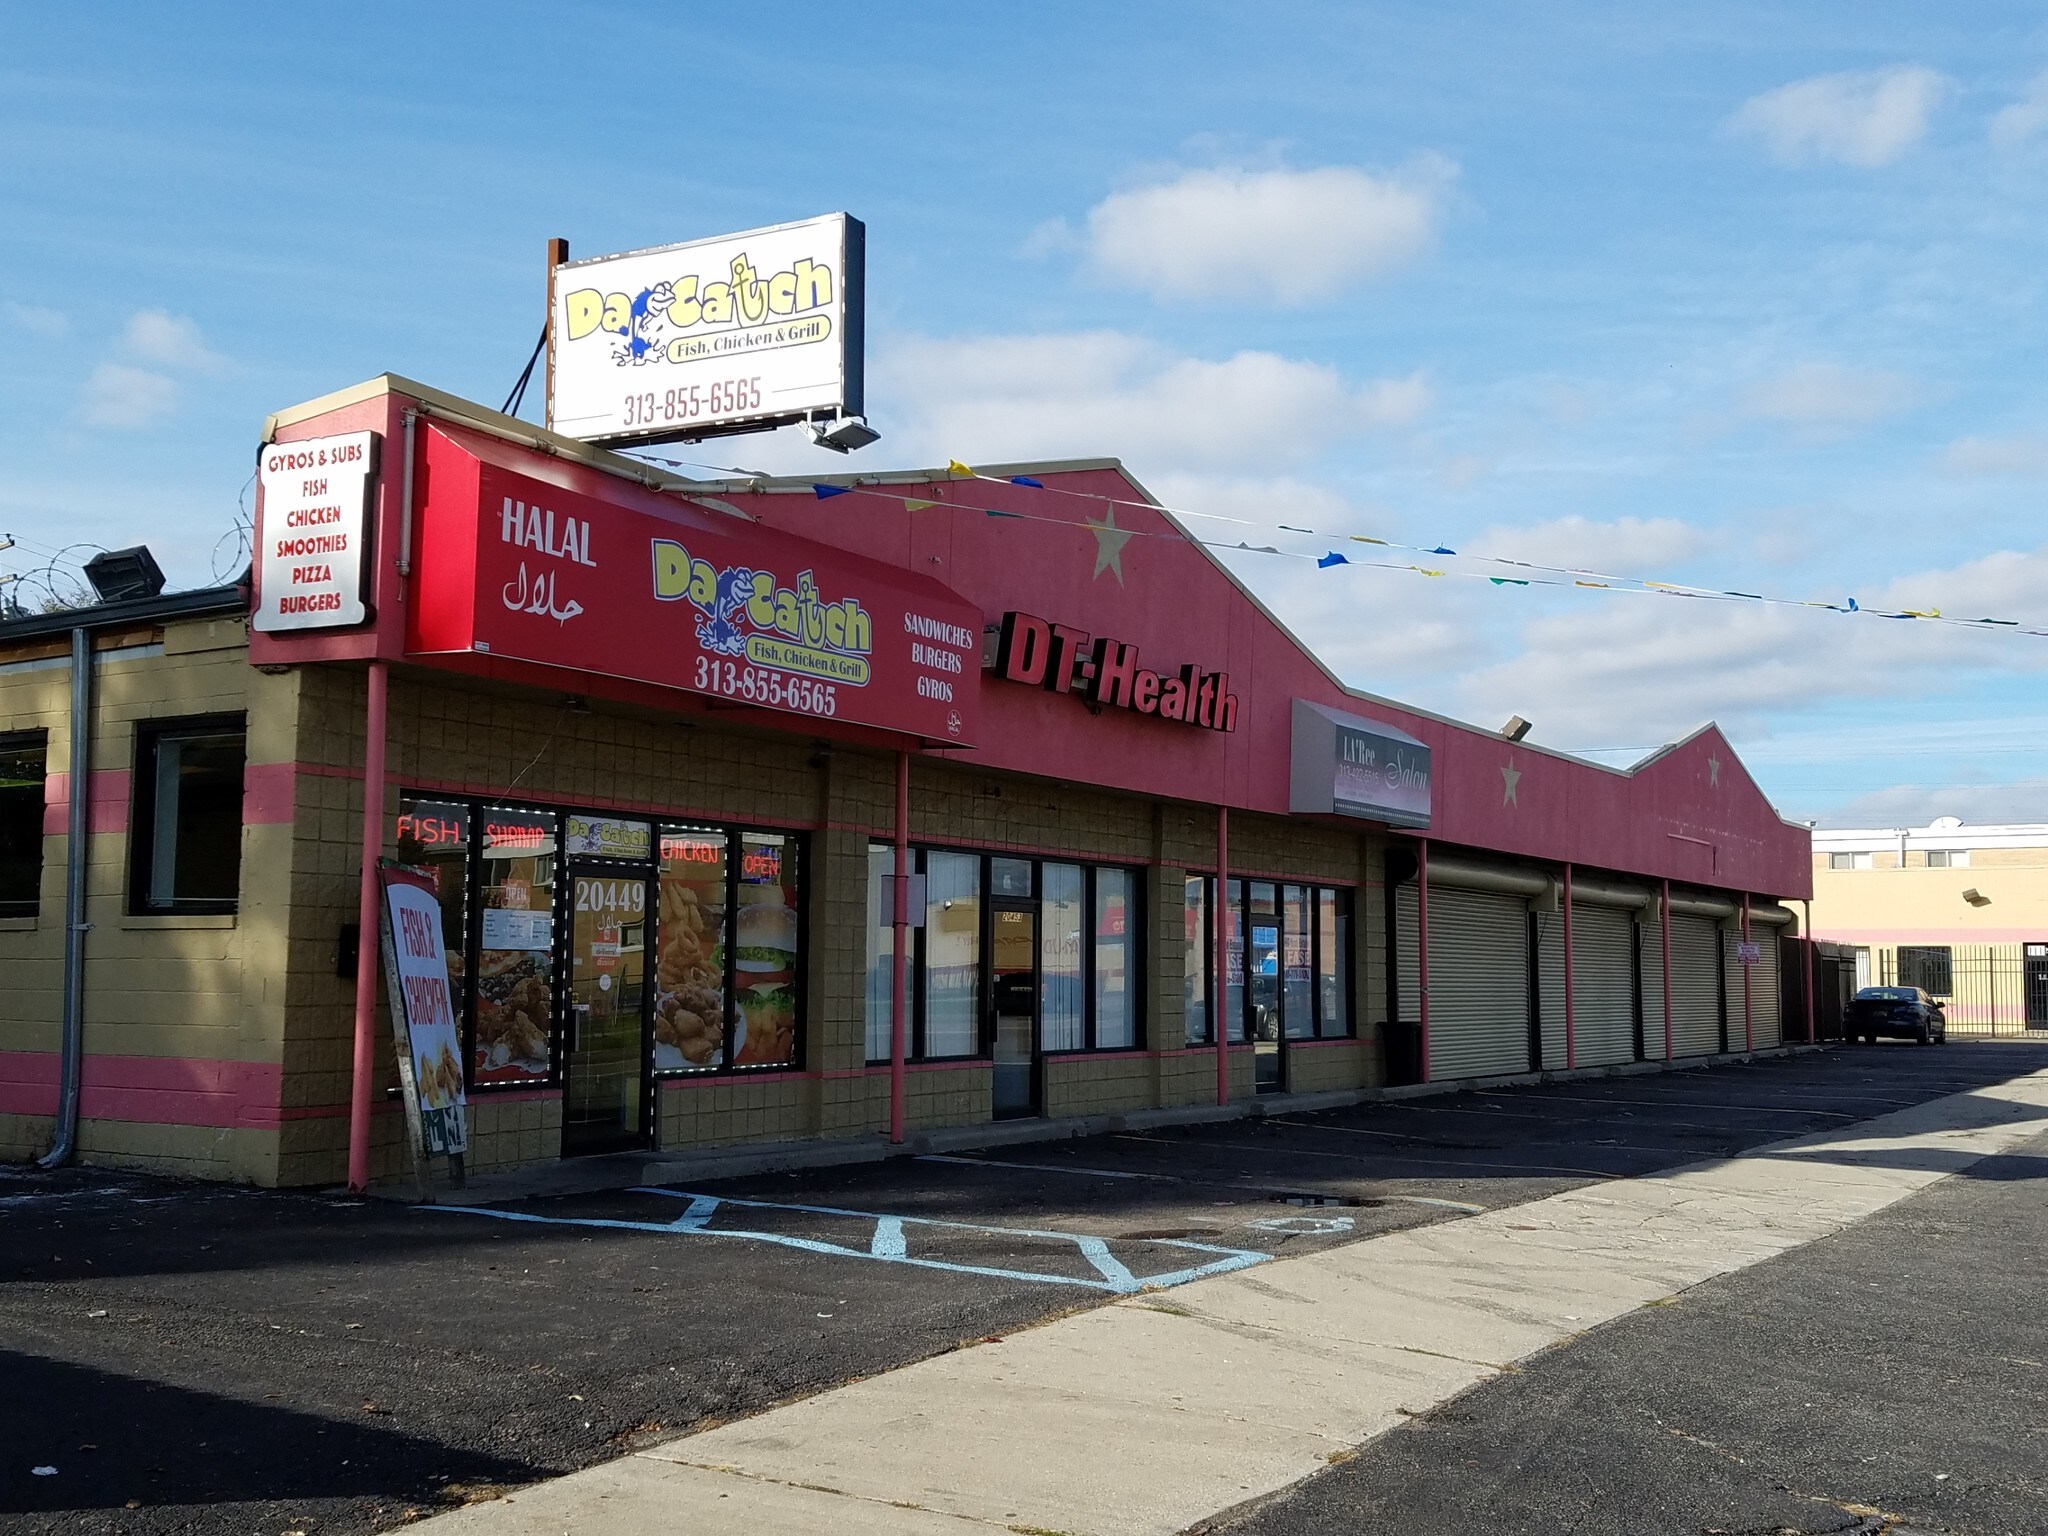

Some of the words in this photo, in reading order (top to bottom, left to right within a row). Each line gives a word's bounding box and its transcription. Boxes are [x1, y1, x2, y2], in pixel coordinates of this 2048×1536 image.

[566, 288, 632, 340] Da
[667, 253, 832, 328] Catch
[677, 342, 710, 358] Fish,
[714, 333, 772, 351] Chicken
[775, 328, 786, 342] &
[788, 322, 820, 340] Grill
[623, 376, 761, 426] 313-855-6565
[268, 450, 315, 473] GYROS
[318, 449, 328, 466] &
[331, 443, 362, 465] SUBS
[302, 478, 328, 498] FISH
[287, 505, 341, 527] CHICKEN
[501, 496, 597, 568] HALAL
[277, 533, 347, 558] SMOOTHIES
[292, 564, 332, 585] PIZZA
[279, 592, 341, 615] BURGERS
[502, 560, 585, 628] حلال
[652, 537, 717, 608] Da
[747, 569, 872, 654] Catch
[904, 612, 973, 650] SANDWICHES
[754, 641, 782, 664] Fish,
[784, 648, 828, 671] Chicken
[830, 659, 838, 673] &
[839, 660, 862, 678] Grill
[911, 642, 962, 674] BURGERS
[695, 656, 836, 717] 313-855-6565
[917, 677, 953, 703] GYROS
[1385, 748, 1427, 790] Salon
[397, 815, 460, 844] FISH
[487, 823, 545, 848] SHRIMP
[568, 818, 589, 838] Da
[600, 821, 650, 846] Catch
[660, 838, 719, 864] CHICKEN
[744, 855, 779, 875] OPEN
[505, 886, 527, 901] OPEN
[576, 880, 646, 912] 20449
[400, 907, 428, 958] FISH
[425, 911, 437, 960] &
[405, 974, 450, 1026] CHICKEN
